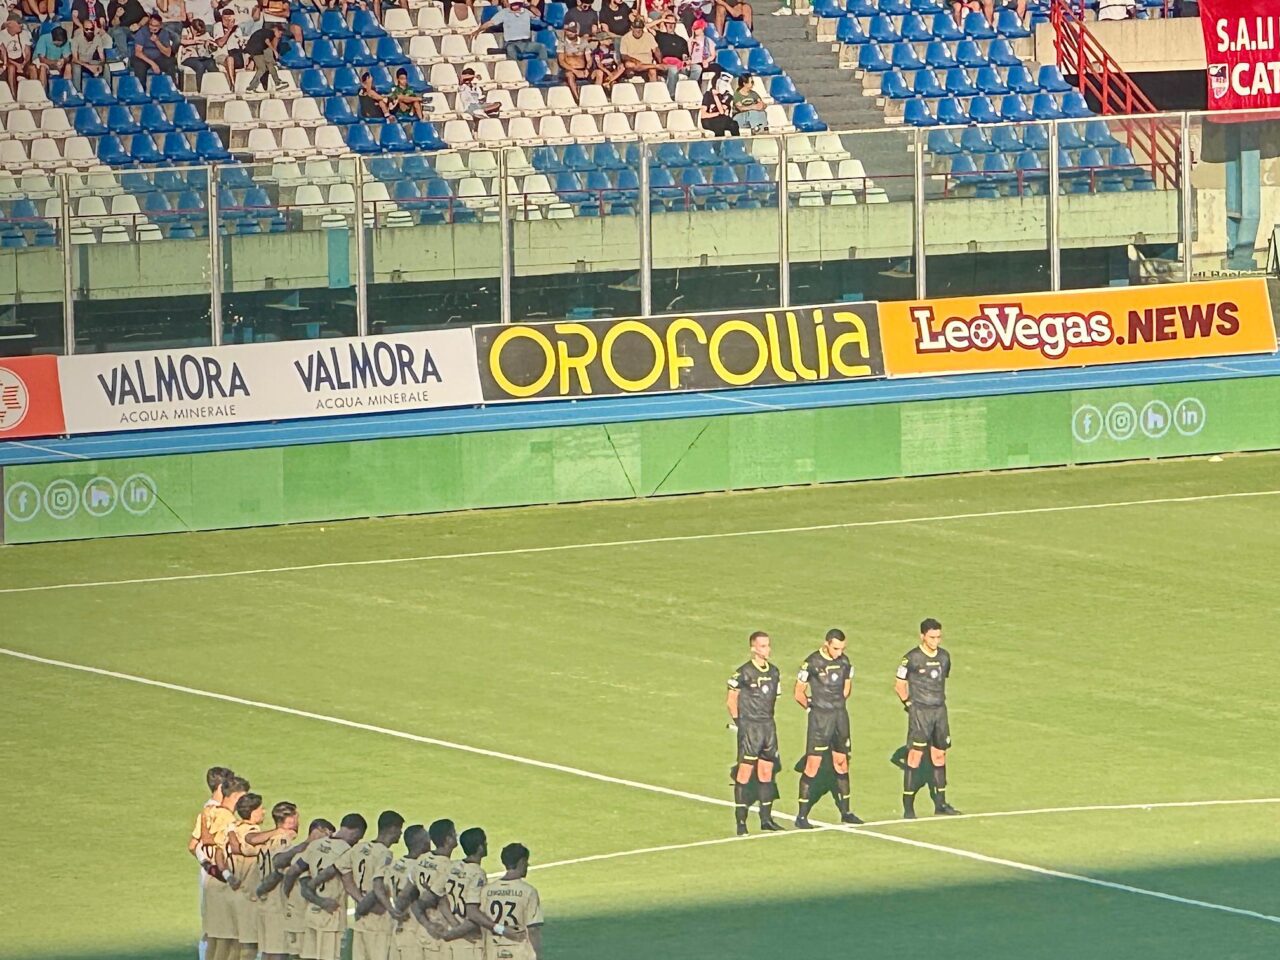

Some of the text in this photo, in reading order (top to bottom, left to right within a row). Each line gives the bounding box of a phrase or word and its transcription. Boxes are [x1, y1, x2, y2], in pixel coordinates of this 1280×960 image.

[97, 353, 251, 406] VALMORA
[293, 341, 443, 393] VALMORA
[119, 404, 237, 424] ACQUA MINERALE
[315, 389, 430, 410] ACQUA MINERALE
[490, 900, 520, 931] 23
